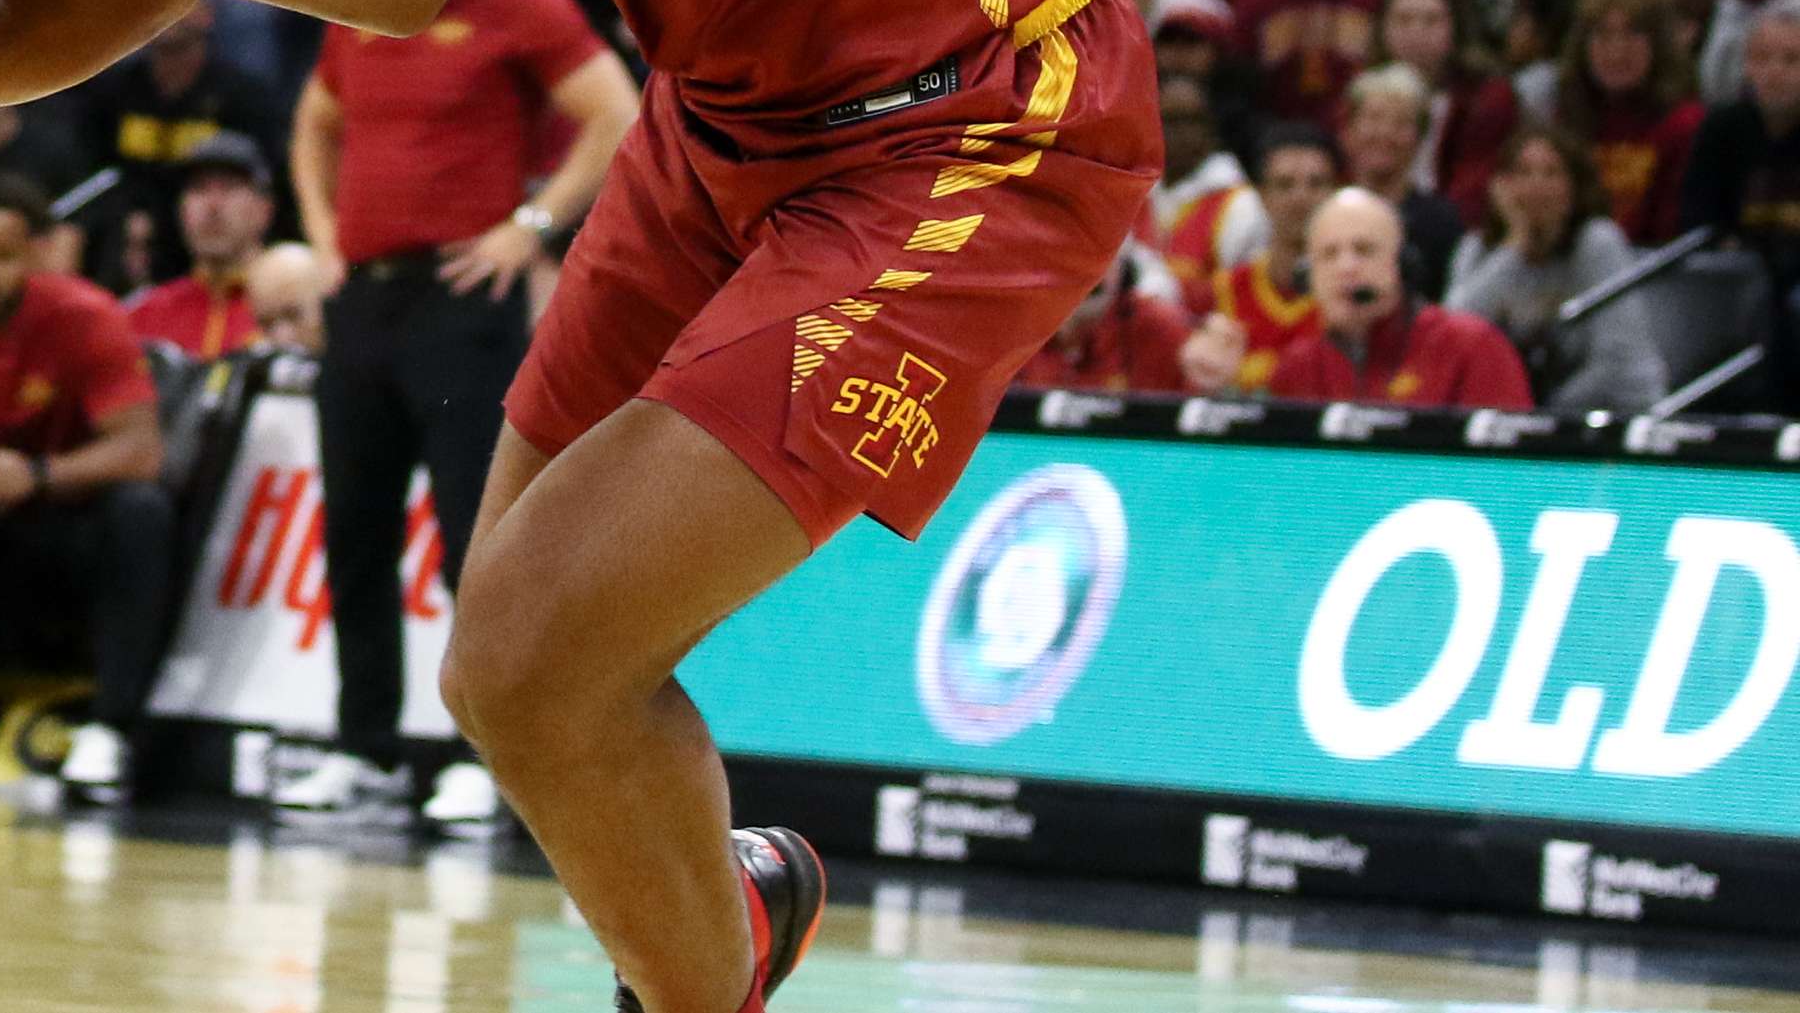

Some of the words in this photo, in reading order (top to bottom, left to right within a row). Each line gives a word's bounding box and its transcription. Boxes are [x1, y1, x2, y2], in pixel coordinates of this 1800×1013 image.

[918, 72, 940, 92] 50
[830, 377, 939, 469] STATE
[1297, 498, 1800, 778] OLD
